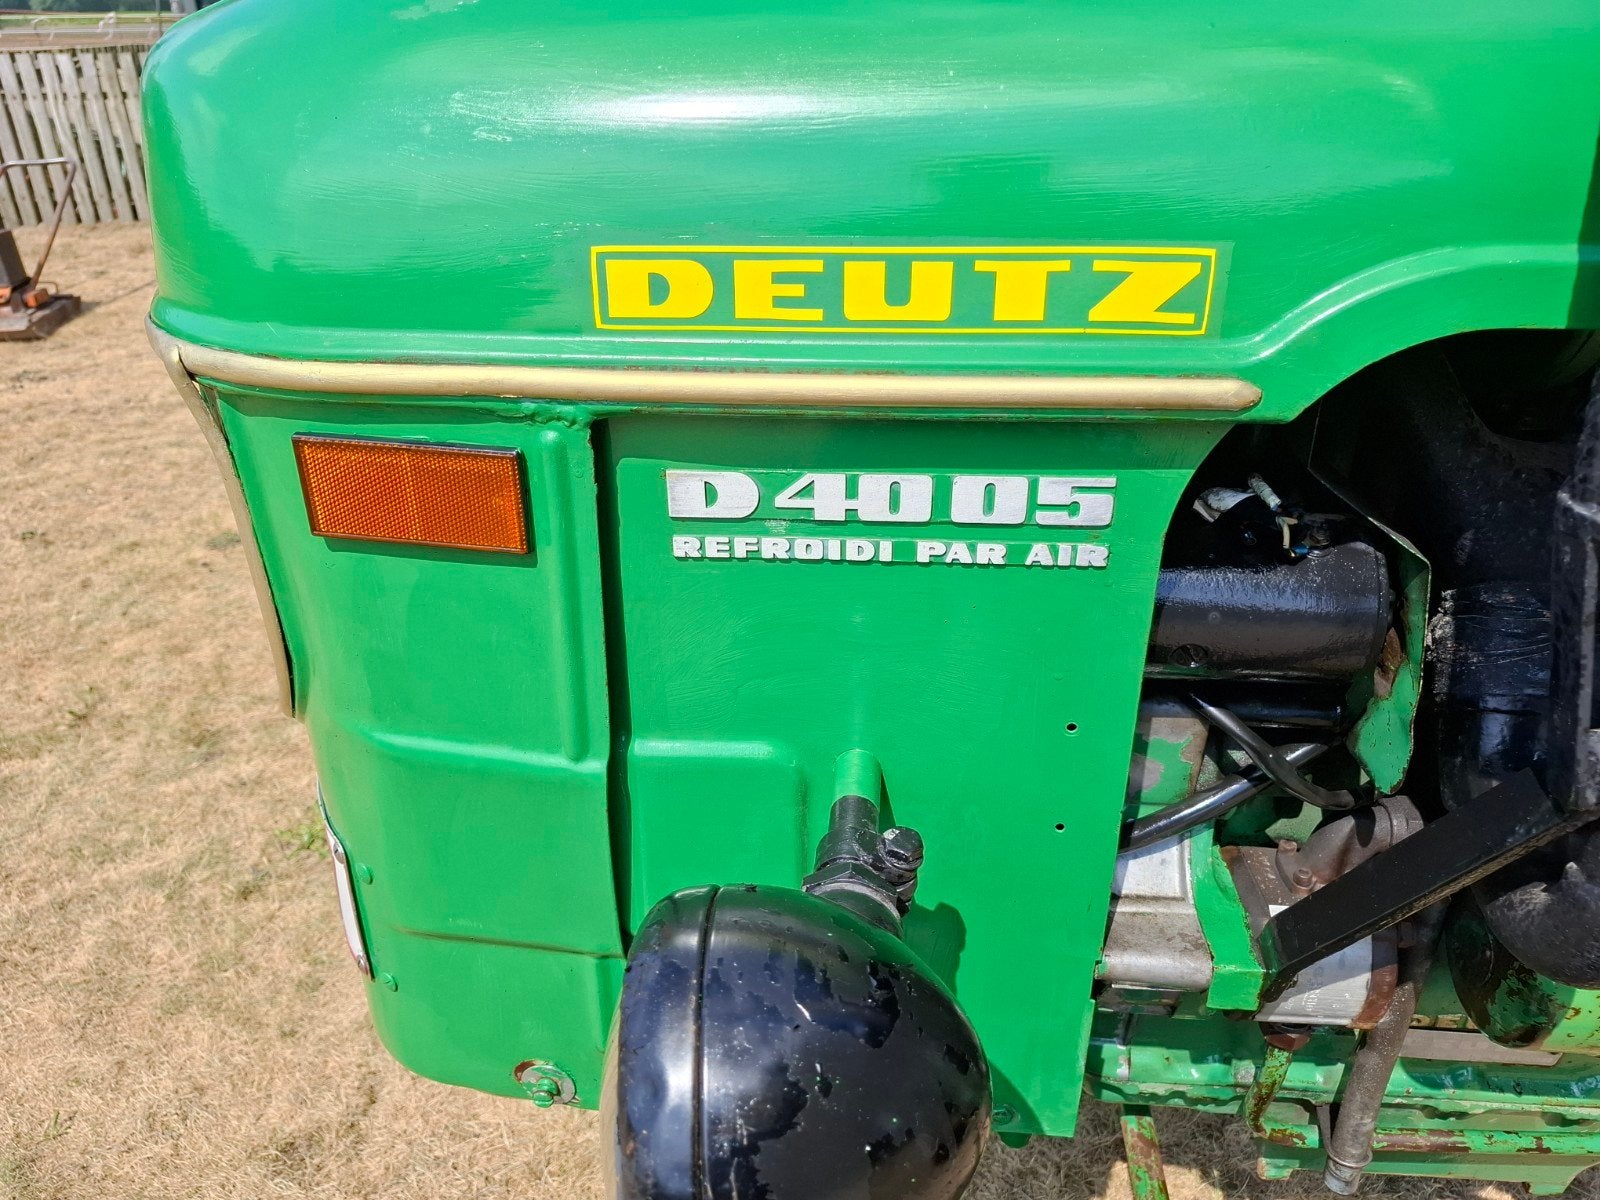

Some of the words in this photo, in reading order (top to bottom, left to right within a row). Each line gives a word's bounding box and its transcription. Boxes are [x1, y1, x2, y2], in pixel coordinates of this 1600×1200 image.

[604, 259, 1202, 325] DEUTZ
[672, 536, 893, 562] REFROIDI
[916, 541, 1007, 564] PAR
[1024, 544, 1109, 567] AIR
